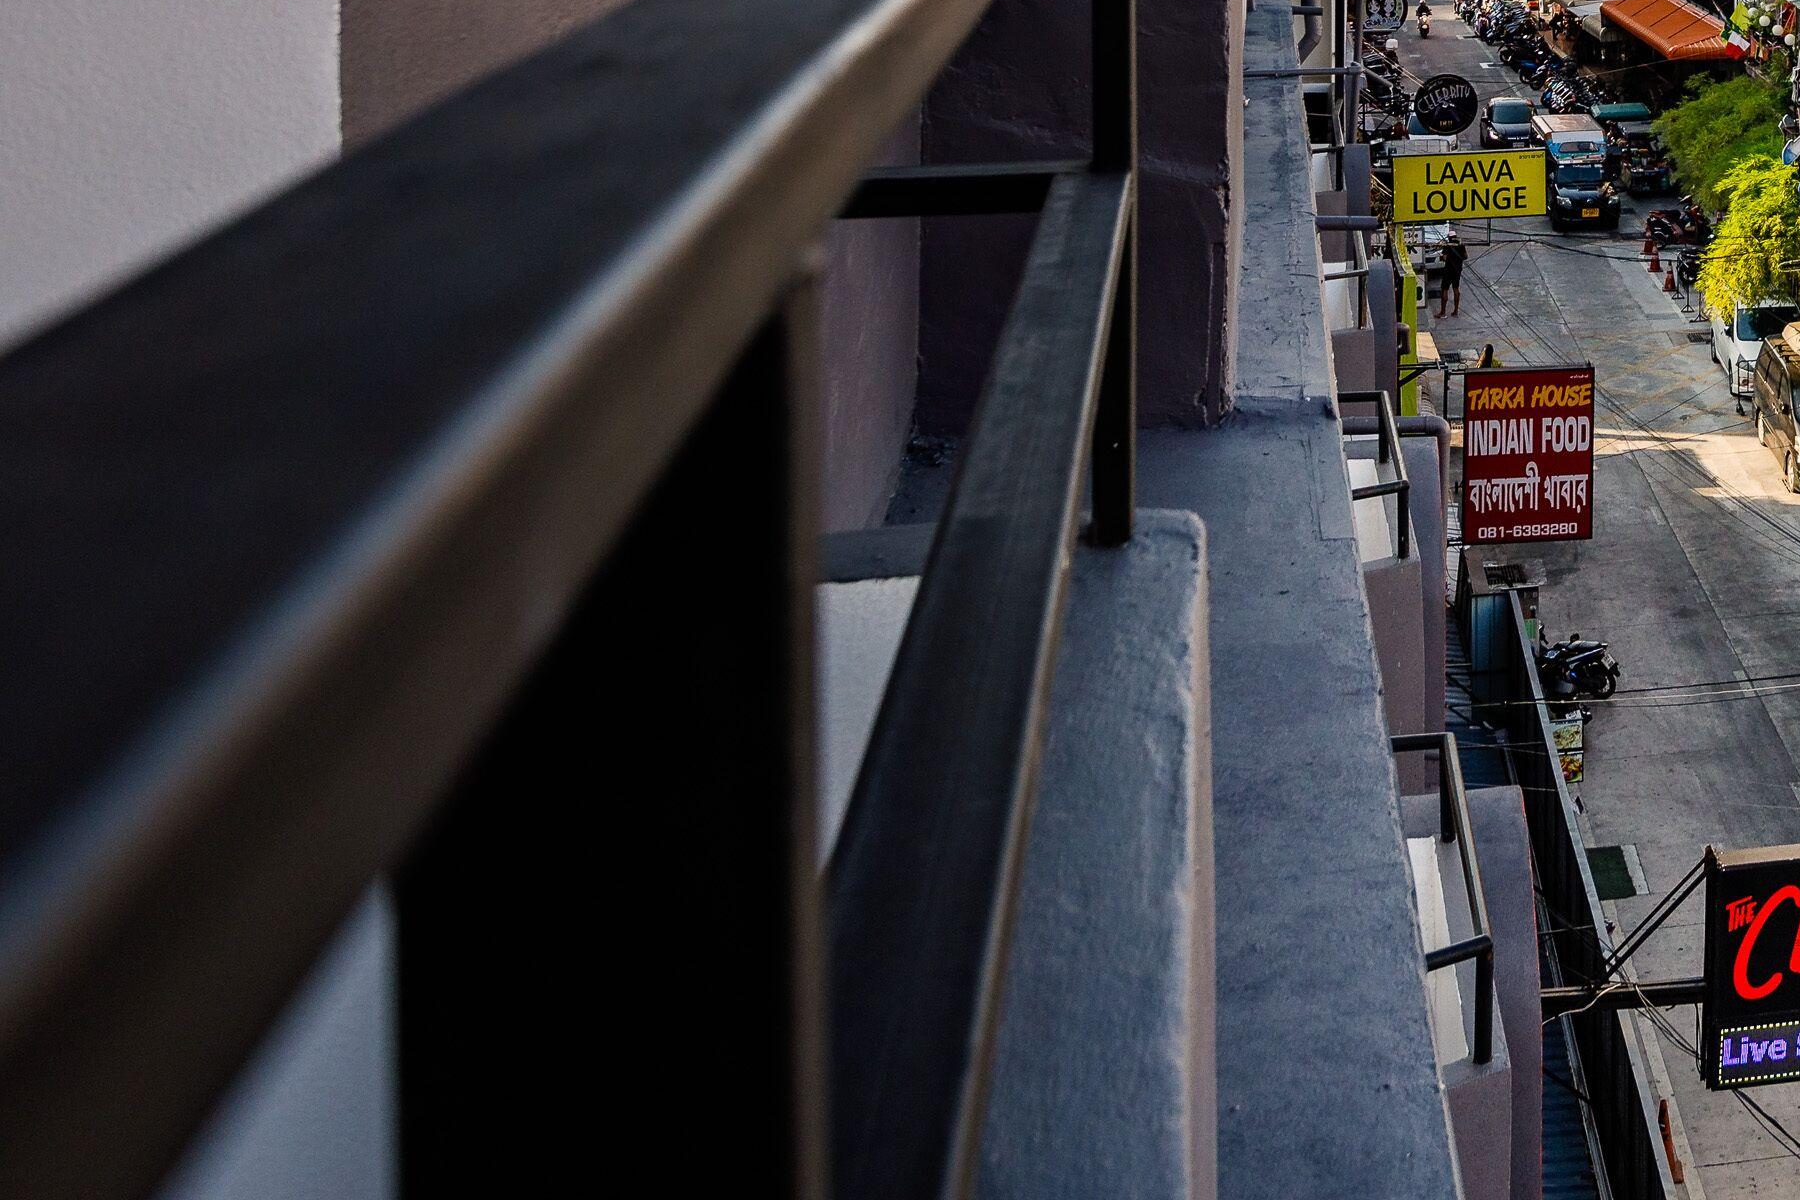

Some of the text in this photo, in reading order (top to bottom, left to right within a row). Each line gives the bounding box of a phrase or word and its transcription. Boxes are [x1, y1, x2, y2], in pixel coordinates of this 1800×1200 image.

[1418, 84, 1471, 113] CELEBRITY
[1425, 157, 1515, 185] LAAVA
[1412, 186, 1527, 214] LOUNGE
[1468, 383, 1592, 410] TARKA HOUSE
[1468, 415, 1590, 456] INDIAN FOOD
[1478, 522, 1578, 539] 081-6393280
[1726, 896, 1757, 932] THE
[1722, 1035, 1787, 1067] Live
